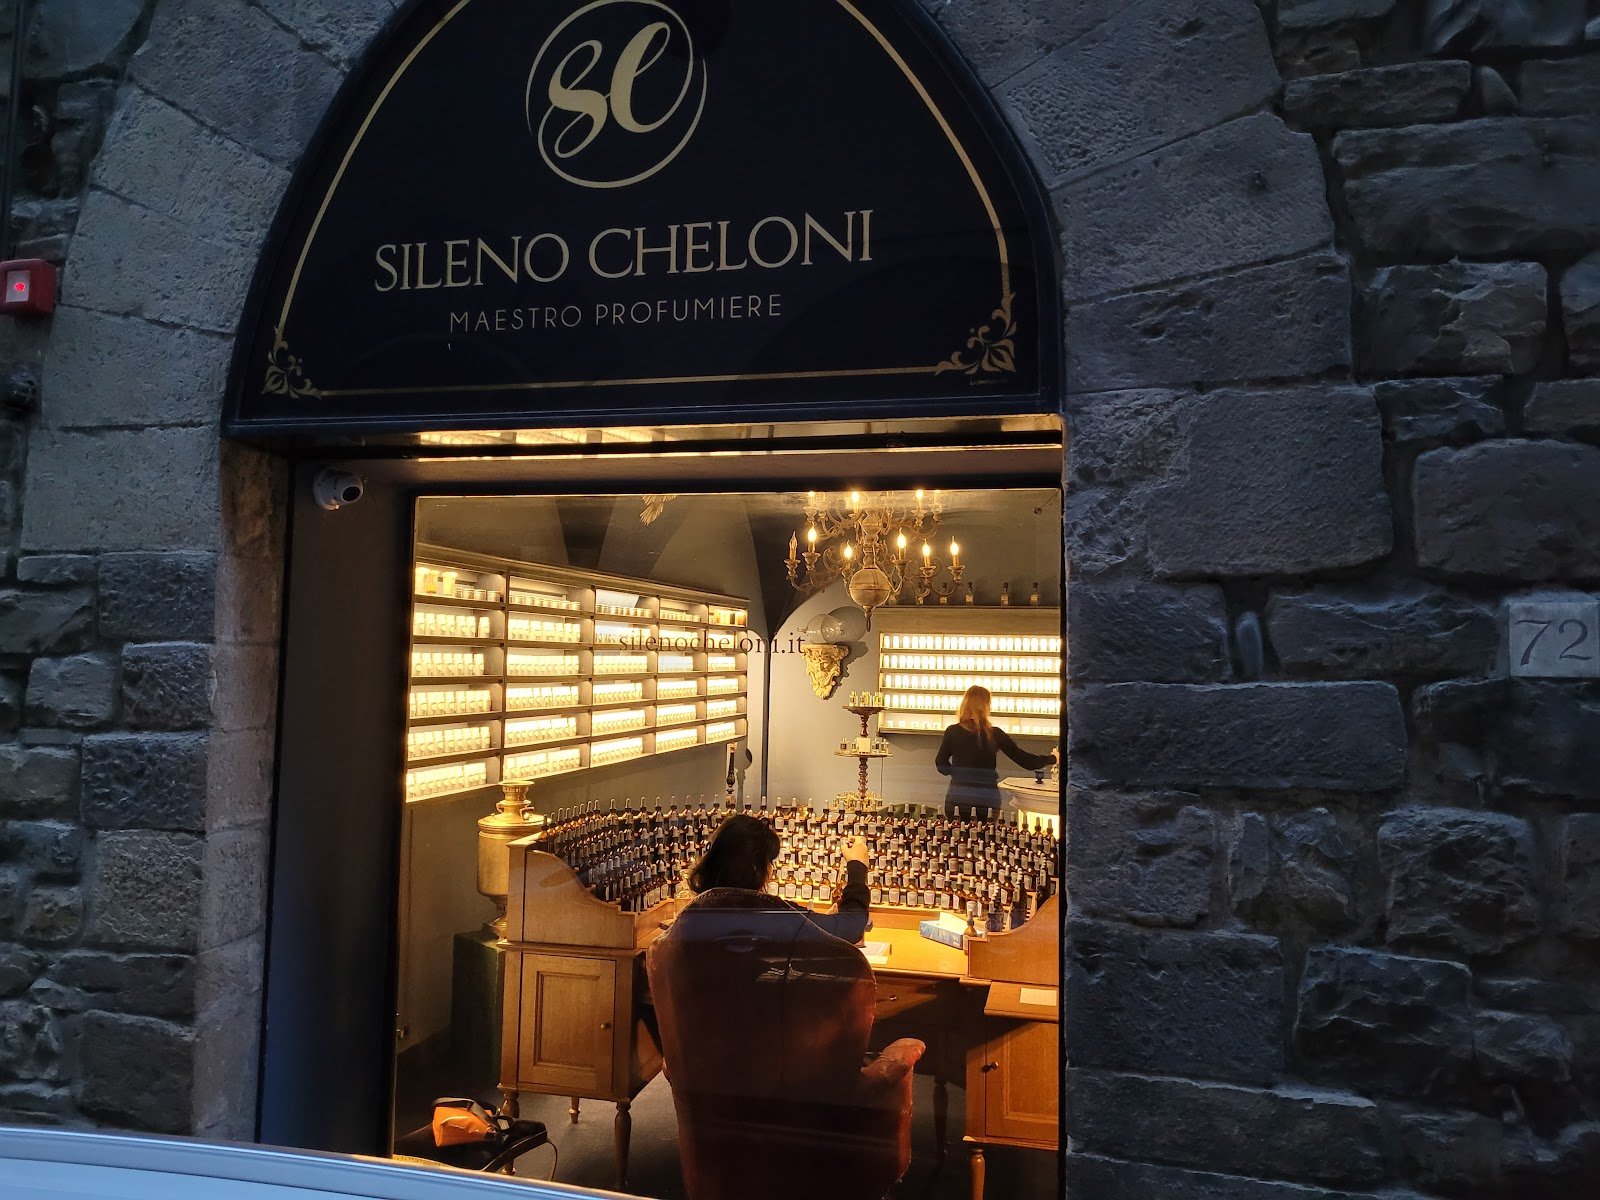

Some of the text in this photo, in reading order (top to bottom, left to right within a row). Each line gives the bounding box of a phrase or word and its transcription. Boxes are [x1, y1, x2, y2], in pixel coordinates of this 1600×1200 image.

[374, 209, 874, 293] SILENO CHELONI
[449, 294, 782, 334] MAESTRO PROFUMIERE
[619, 629, 806, 654] silenocheloni.it
[1516, 619, 1591, 665] 72
